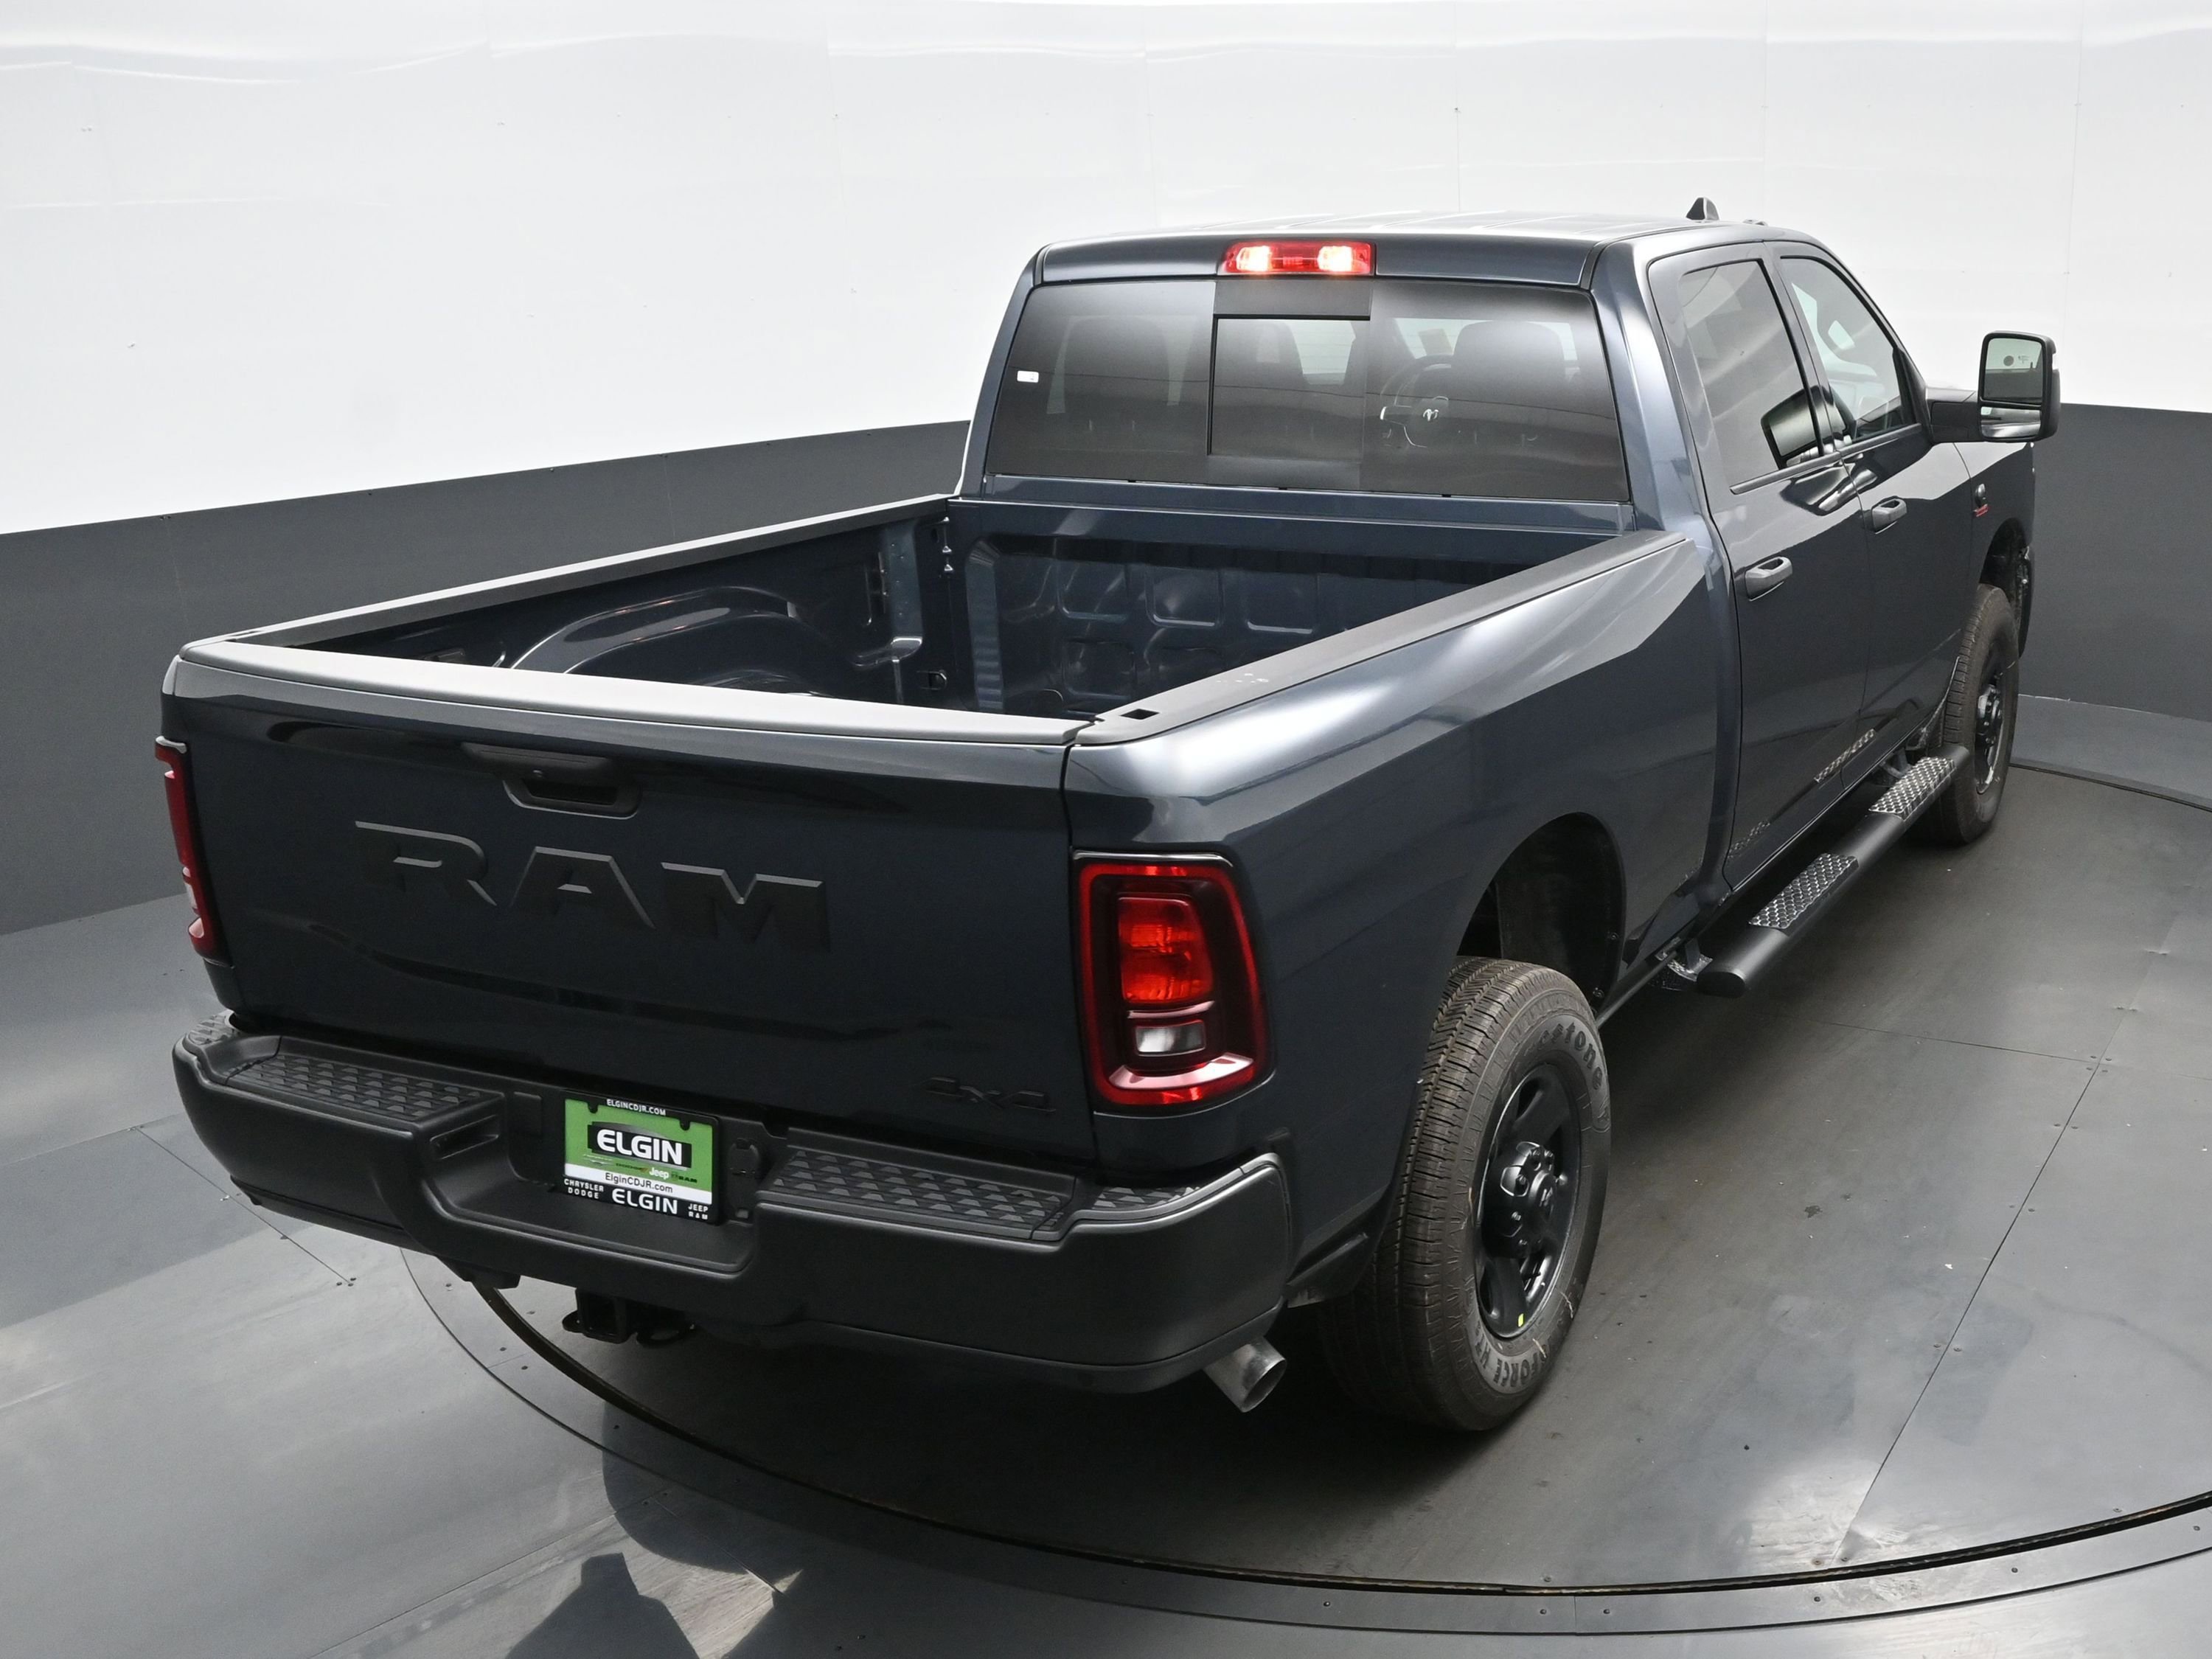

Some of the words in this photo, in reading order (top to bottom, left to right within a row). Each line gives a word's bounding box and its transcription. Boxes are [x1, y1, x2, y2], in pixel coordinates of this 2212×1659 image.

[355, 820, 832, 953] RAM
[607, 1099, 667, 1116] ELGINCDJR.COM
[597, 1129, 682, 1165] ELGIN
[649, 1167, 669, 1179] Jeep
[564, 1178, 604, 1192] CHRYSLER
[605, 1172, 673, 1193] ElginCDJR.com
[568, 1187, 599, 1199] DODGE
[612, 1188, 678, 1214] ELGIN
[688, 1203, 709, 1212] JEEP
[689, 1211, 709, 1220] RAM
